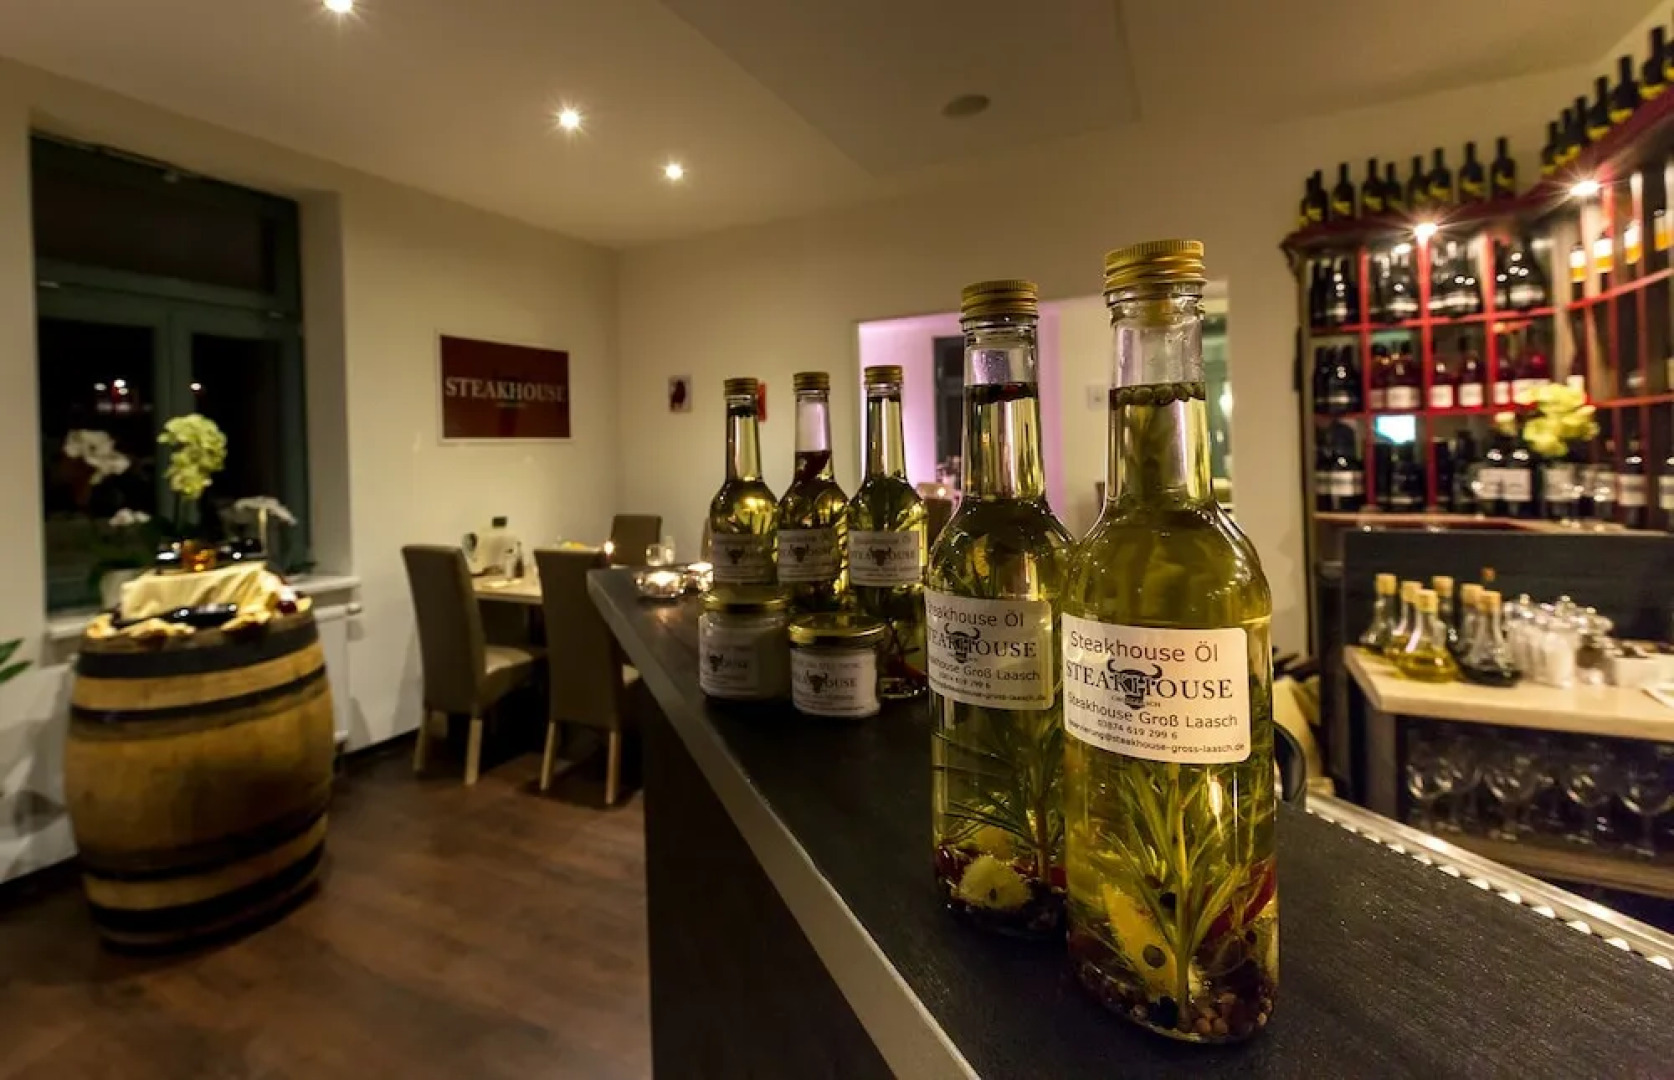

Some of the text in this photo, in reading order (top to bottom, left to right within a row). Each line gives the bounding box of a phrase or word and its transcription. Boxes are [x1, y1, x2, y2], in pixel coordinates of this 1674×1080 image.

[446, 376, 566, 402] STEAKHOUSE
[1004, 609, 1024, 627] Öl
[1070, 630, 1218, 662] Steakhouse Öl
[963, 664, 992, 679] Groß
[996, 669, 1041, 681] Laasch
[1066, 659, 1233, 700] STEAKHOUSE
[1068, 691, 1133, 722] Steakhouse
[1139, 710, 1179, 728] Groß
[1186, 714, 1238, 729] Laasch
[1126, 725, 1145, 736] 619
[1149, 728, 1168, 739] 299
[1171, 731, 1178, 740] 6
